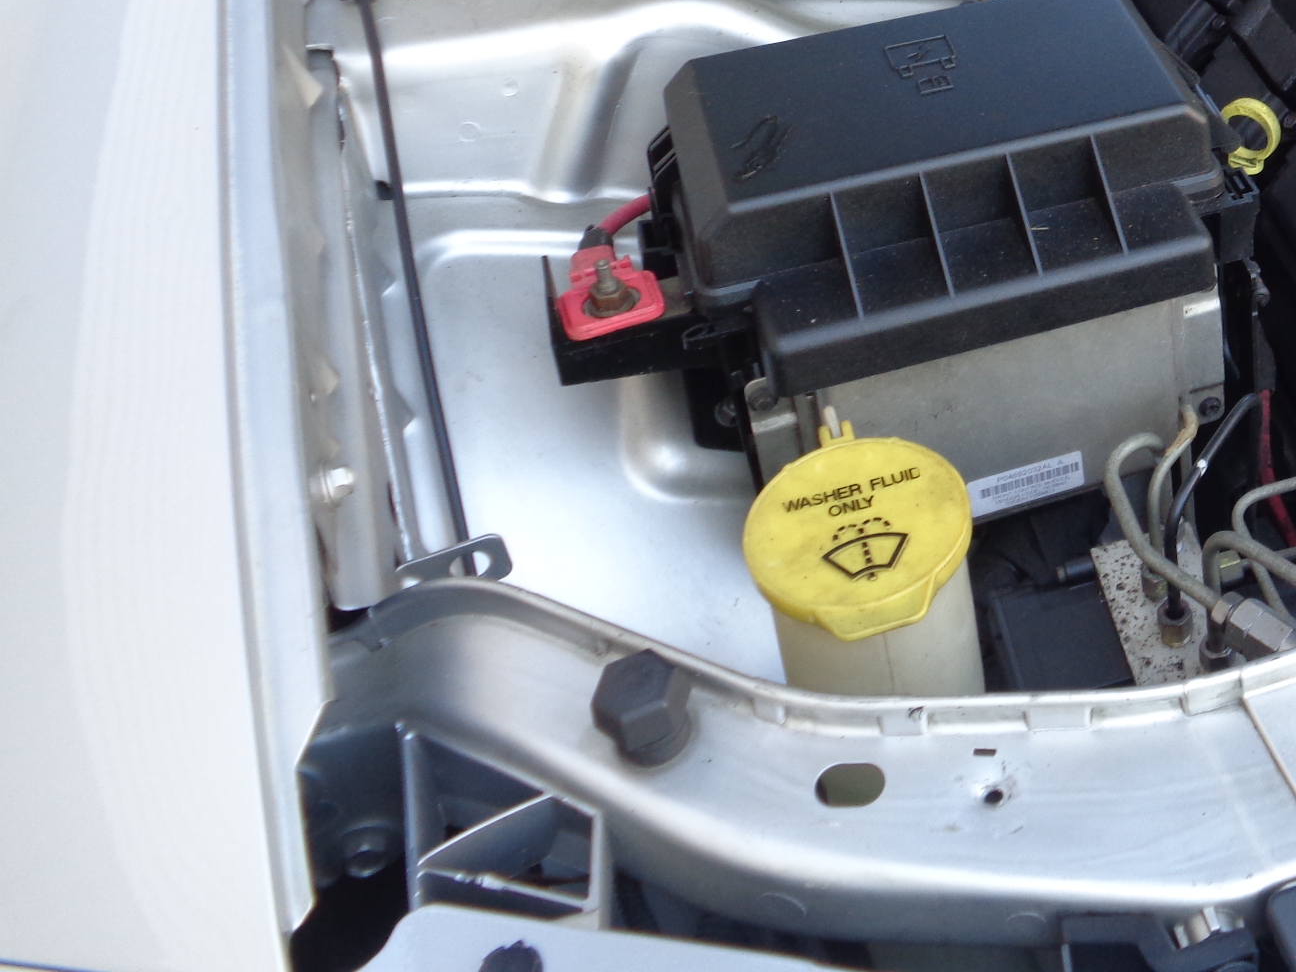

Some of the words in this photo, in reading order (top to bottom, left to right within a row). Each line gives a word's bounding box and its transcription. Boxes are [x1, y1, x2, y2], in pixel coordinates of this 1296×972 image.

[783, 482, 863, 514] WASHER
[869, 466, 921, 493] FLUID
[827, 495, 875, 519] ONLY
